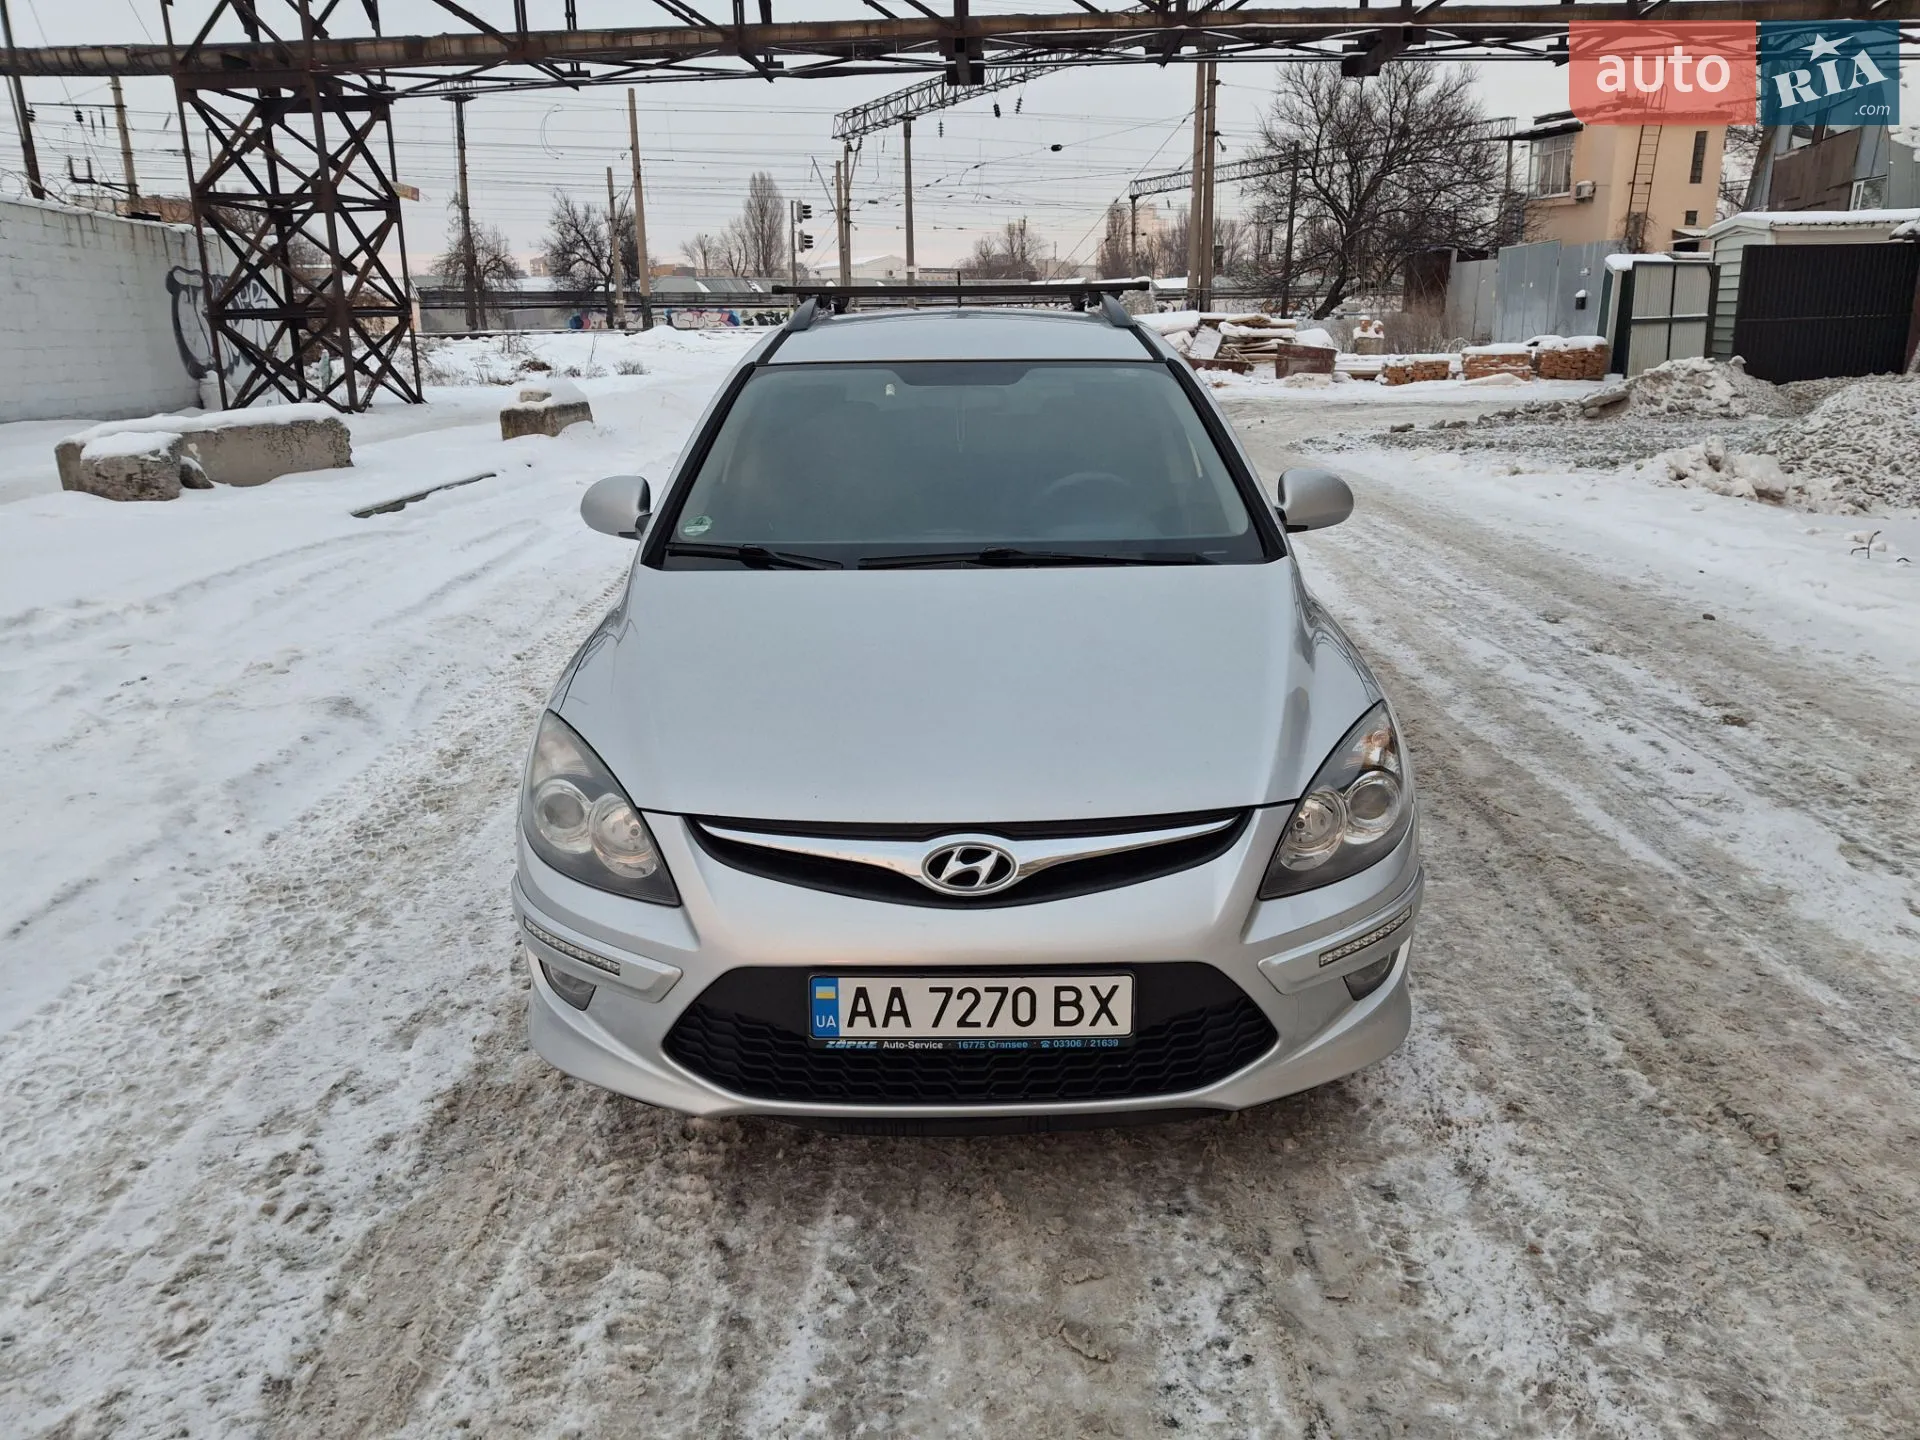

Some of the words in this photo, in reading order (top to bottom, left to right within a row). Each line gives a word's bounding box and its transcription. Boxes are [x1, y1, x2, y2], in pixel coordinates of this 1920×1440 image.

[847, 986, 912, 1028] AA
[928, 986, 1037, 1028] 7270
[1053, 984, 1120, 1027] BX
[816, 1015, 837, 1028] UA
[882, 1040, 943, 1049] Auto-Service
[957, 1040, 986, 1049] 16775
[988, 1040, 1029, 1049] Gransee
[1090, 1039, 1119, 1048] 21639
